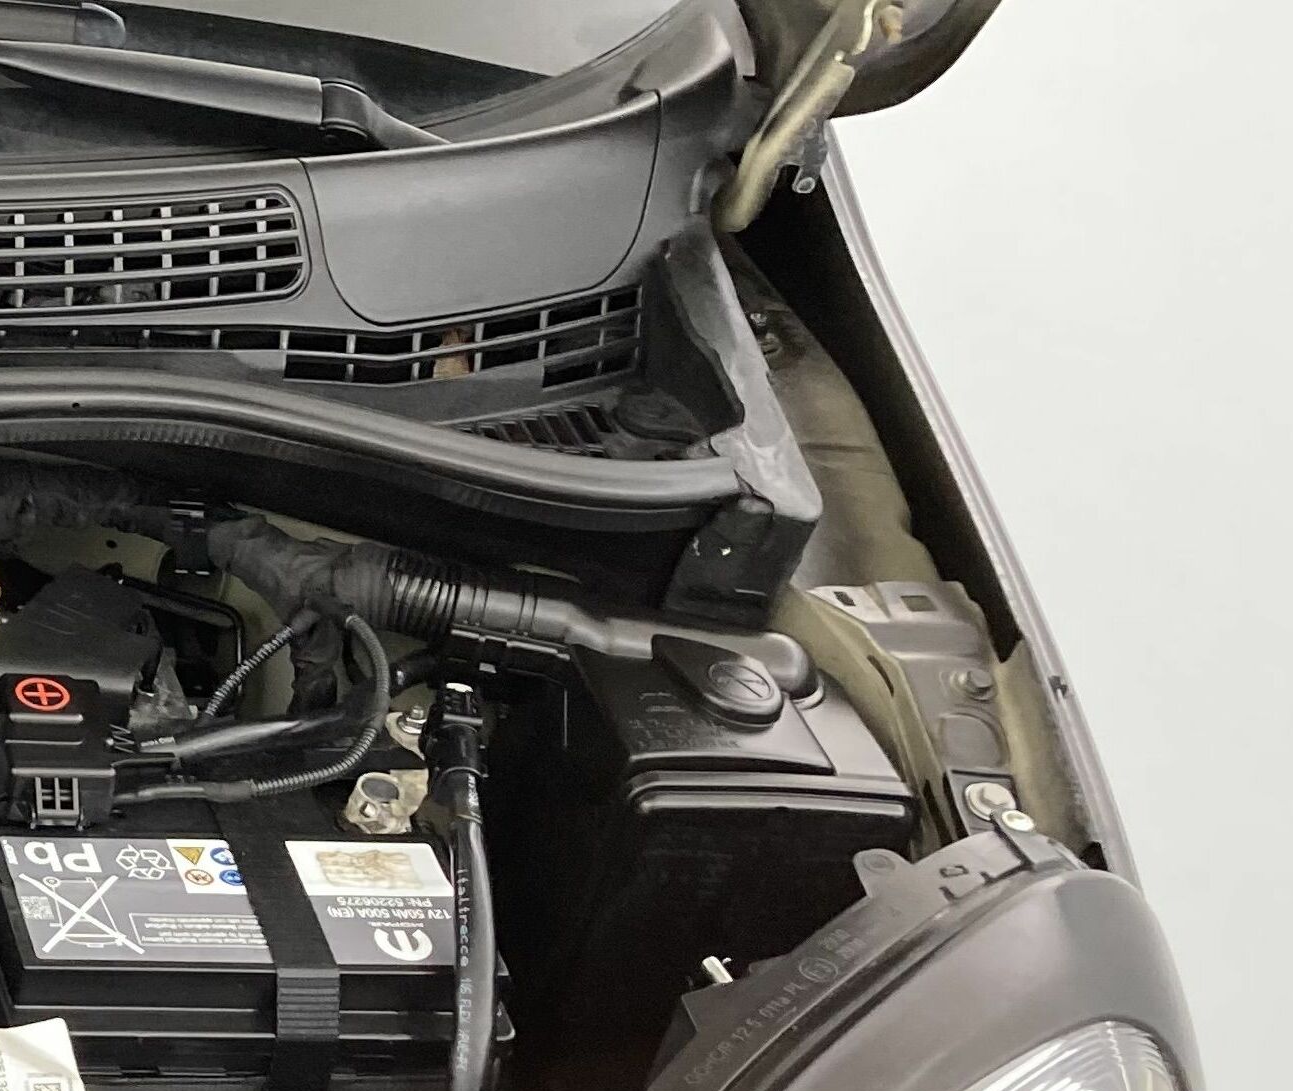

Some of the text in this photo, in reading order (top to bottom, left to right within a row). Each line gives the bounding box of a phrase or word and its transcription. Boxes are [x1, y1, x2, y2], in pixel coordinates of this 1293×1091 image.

[24, 841, 102, 872] Pb
[326, 906, 355, 918] (EN)
[427, 908, 453, 920] 12V
